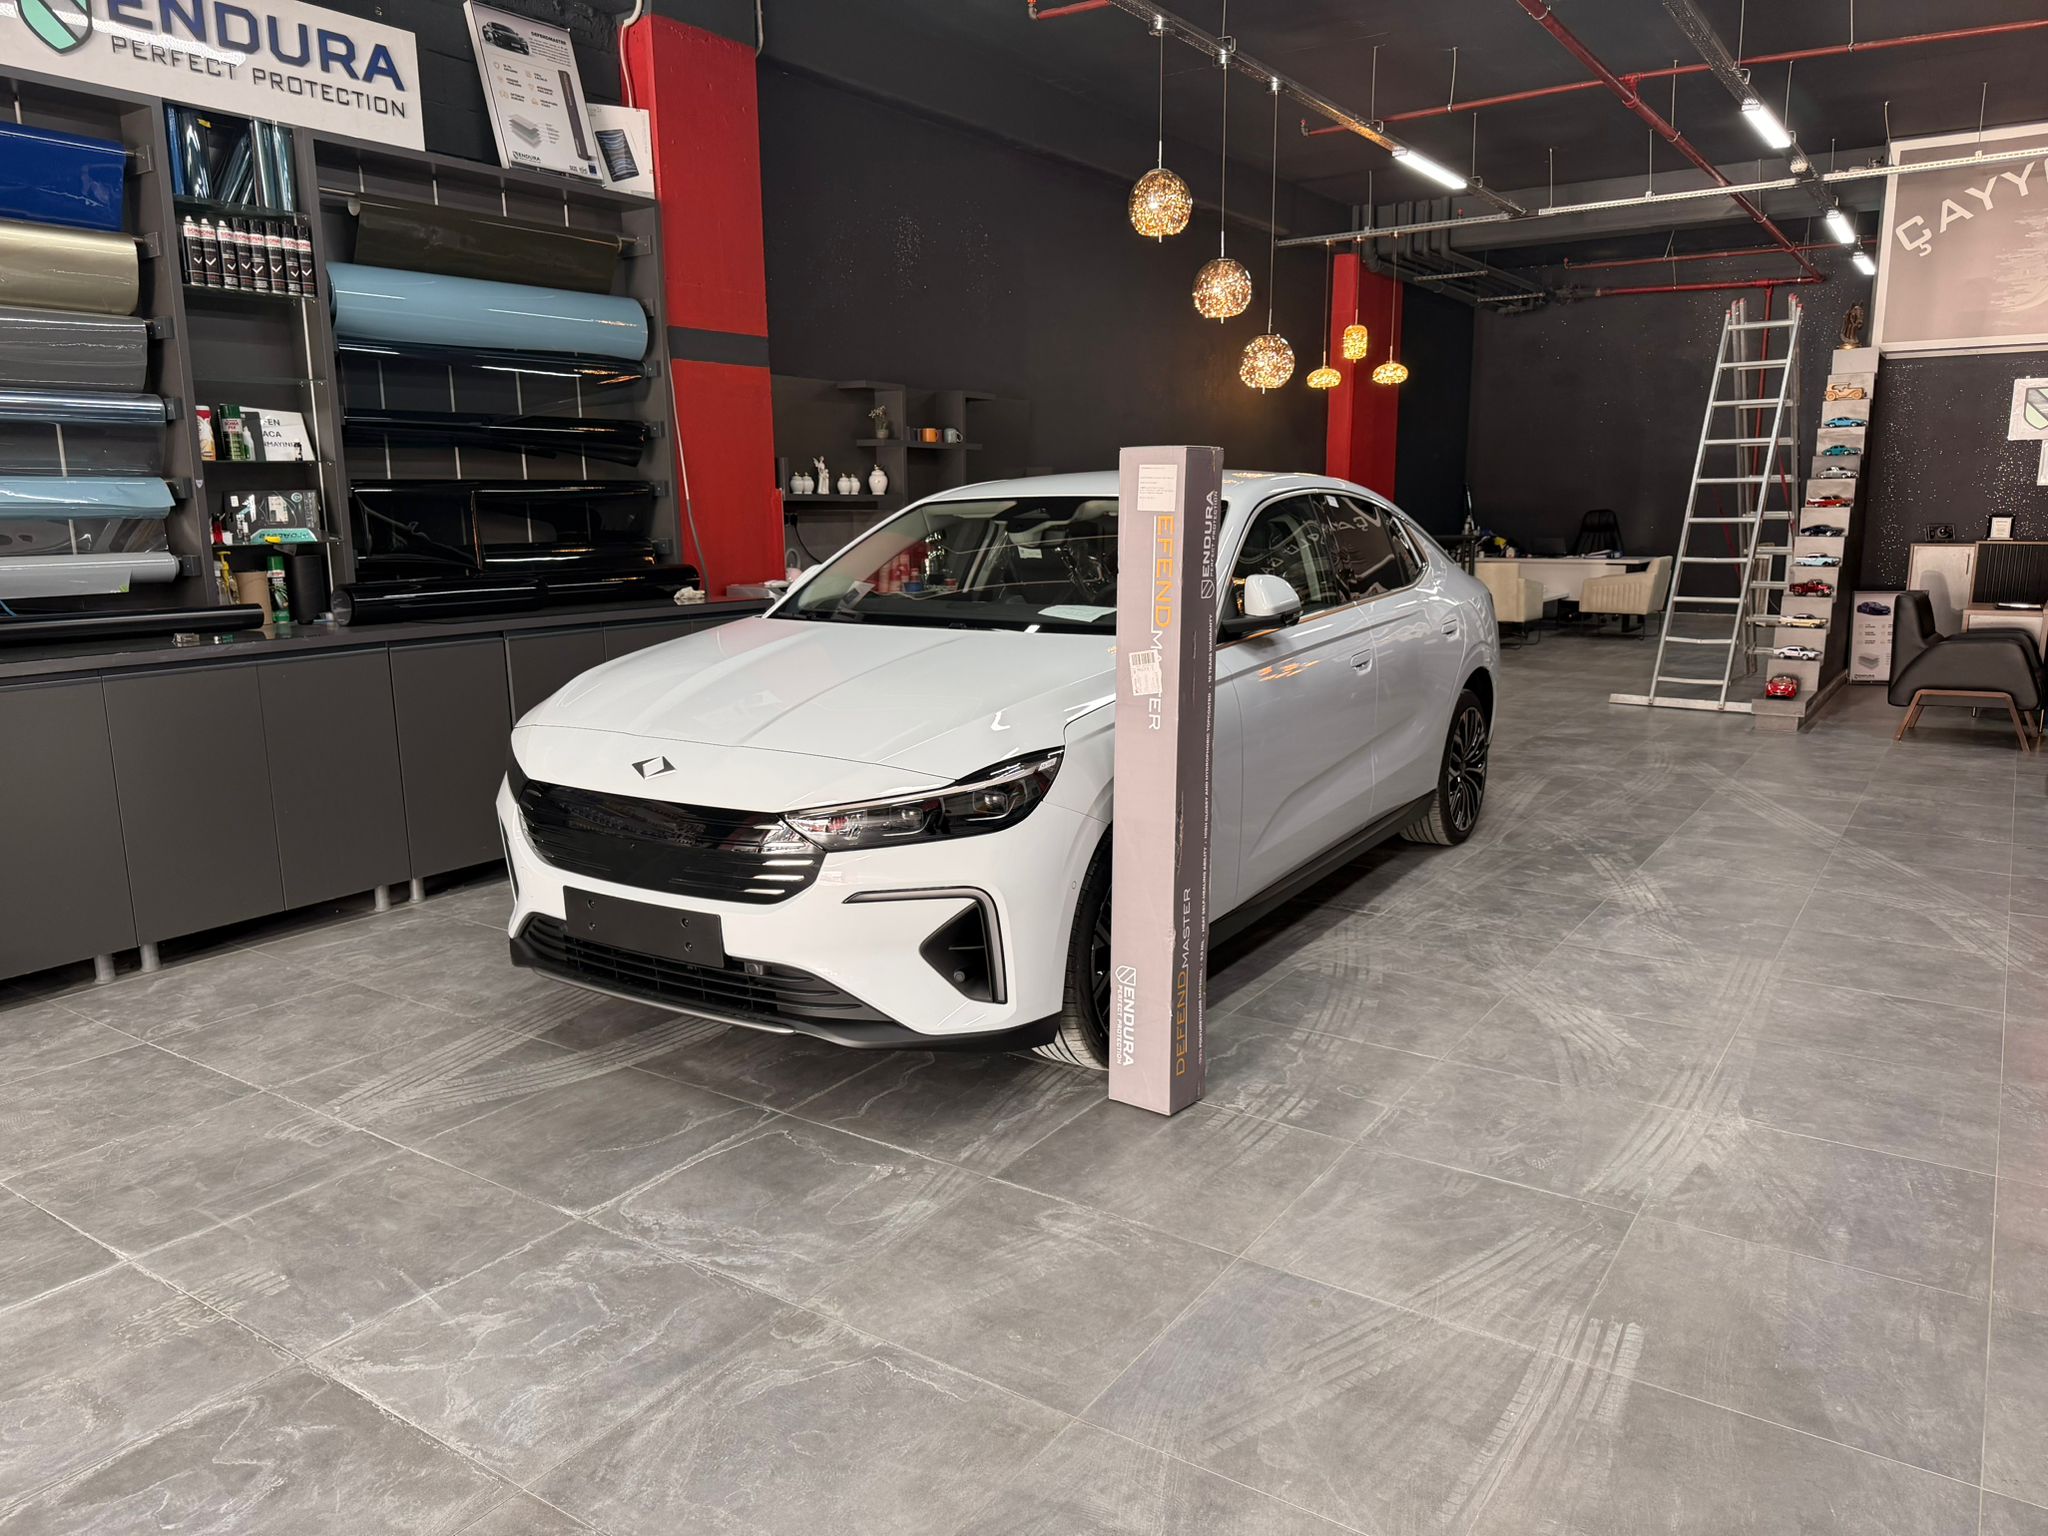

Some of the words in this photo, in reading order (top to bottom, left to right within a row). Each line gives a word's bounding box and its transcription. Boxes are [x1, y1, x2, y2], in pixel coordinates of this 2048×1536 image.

[107, 0, 406, 92] ENDURA
[112, 35, 238, 80] PERFECT
[253, 68, 407, 119] PROTECTION
[1895, 158, 2048, 258] ÇAYY
[1202, 490, 1215, 578] ENDURA
[1122, 986, 1136, 1066] ENDURA
[1176, 888, 1191, 1077] DEFENDMASTER
[1115, 1018, 1123, 1065] PROTECTION
